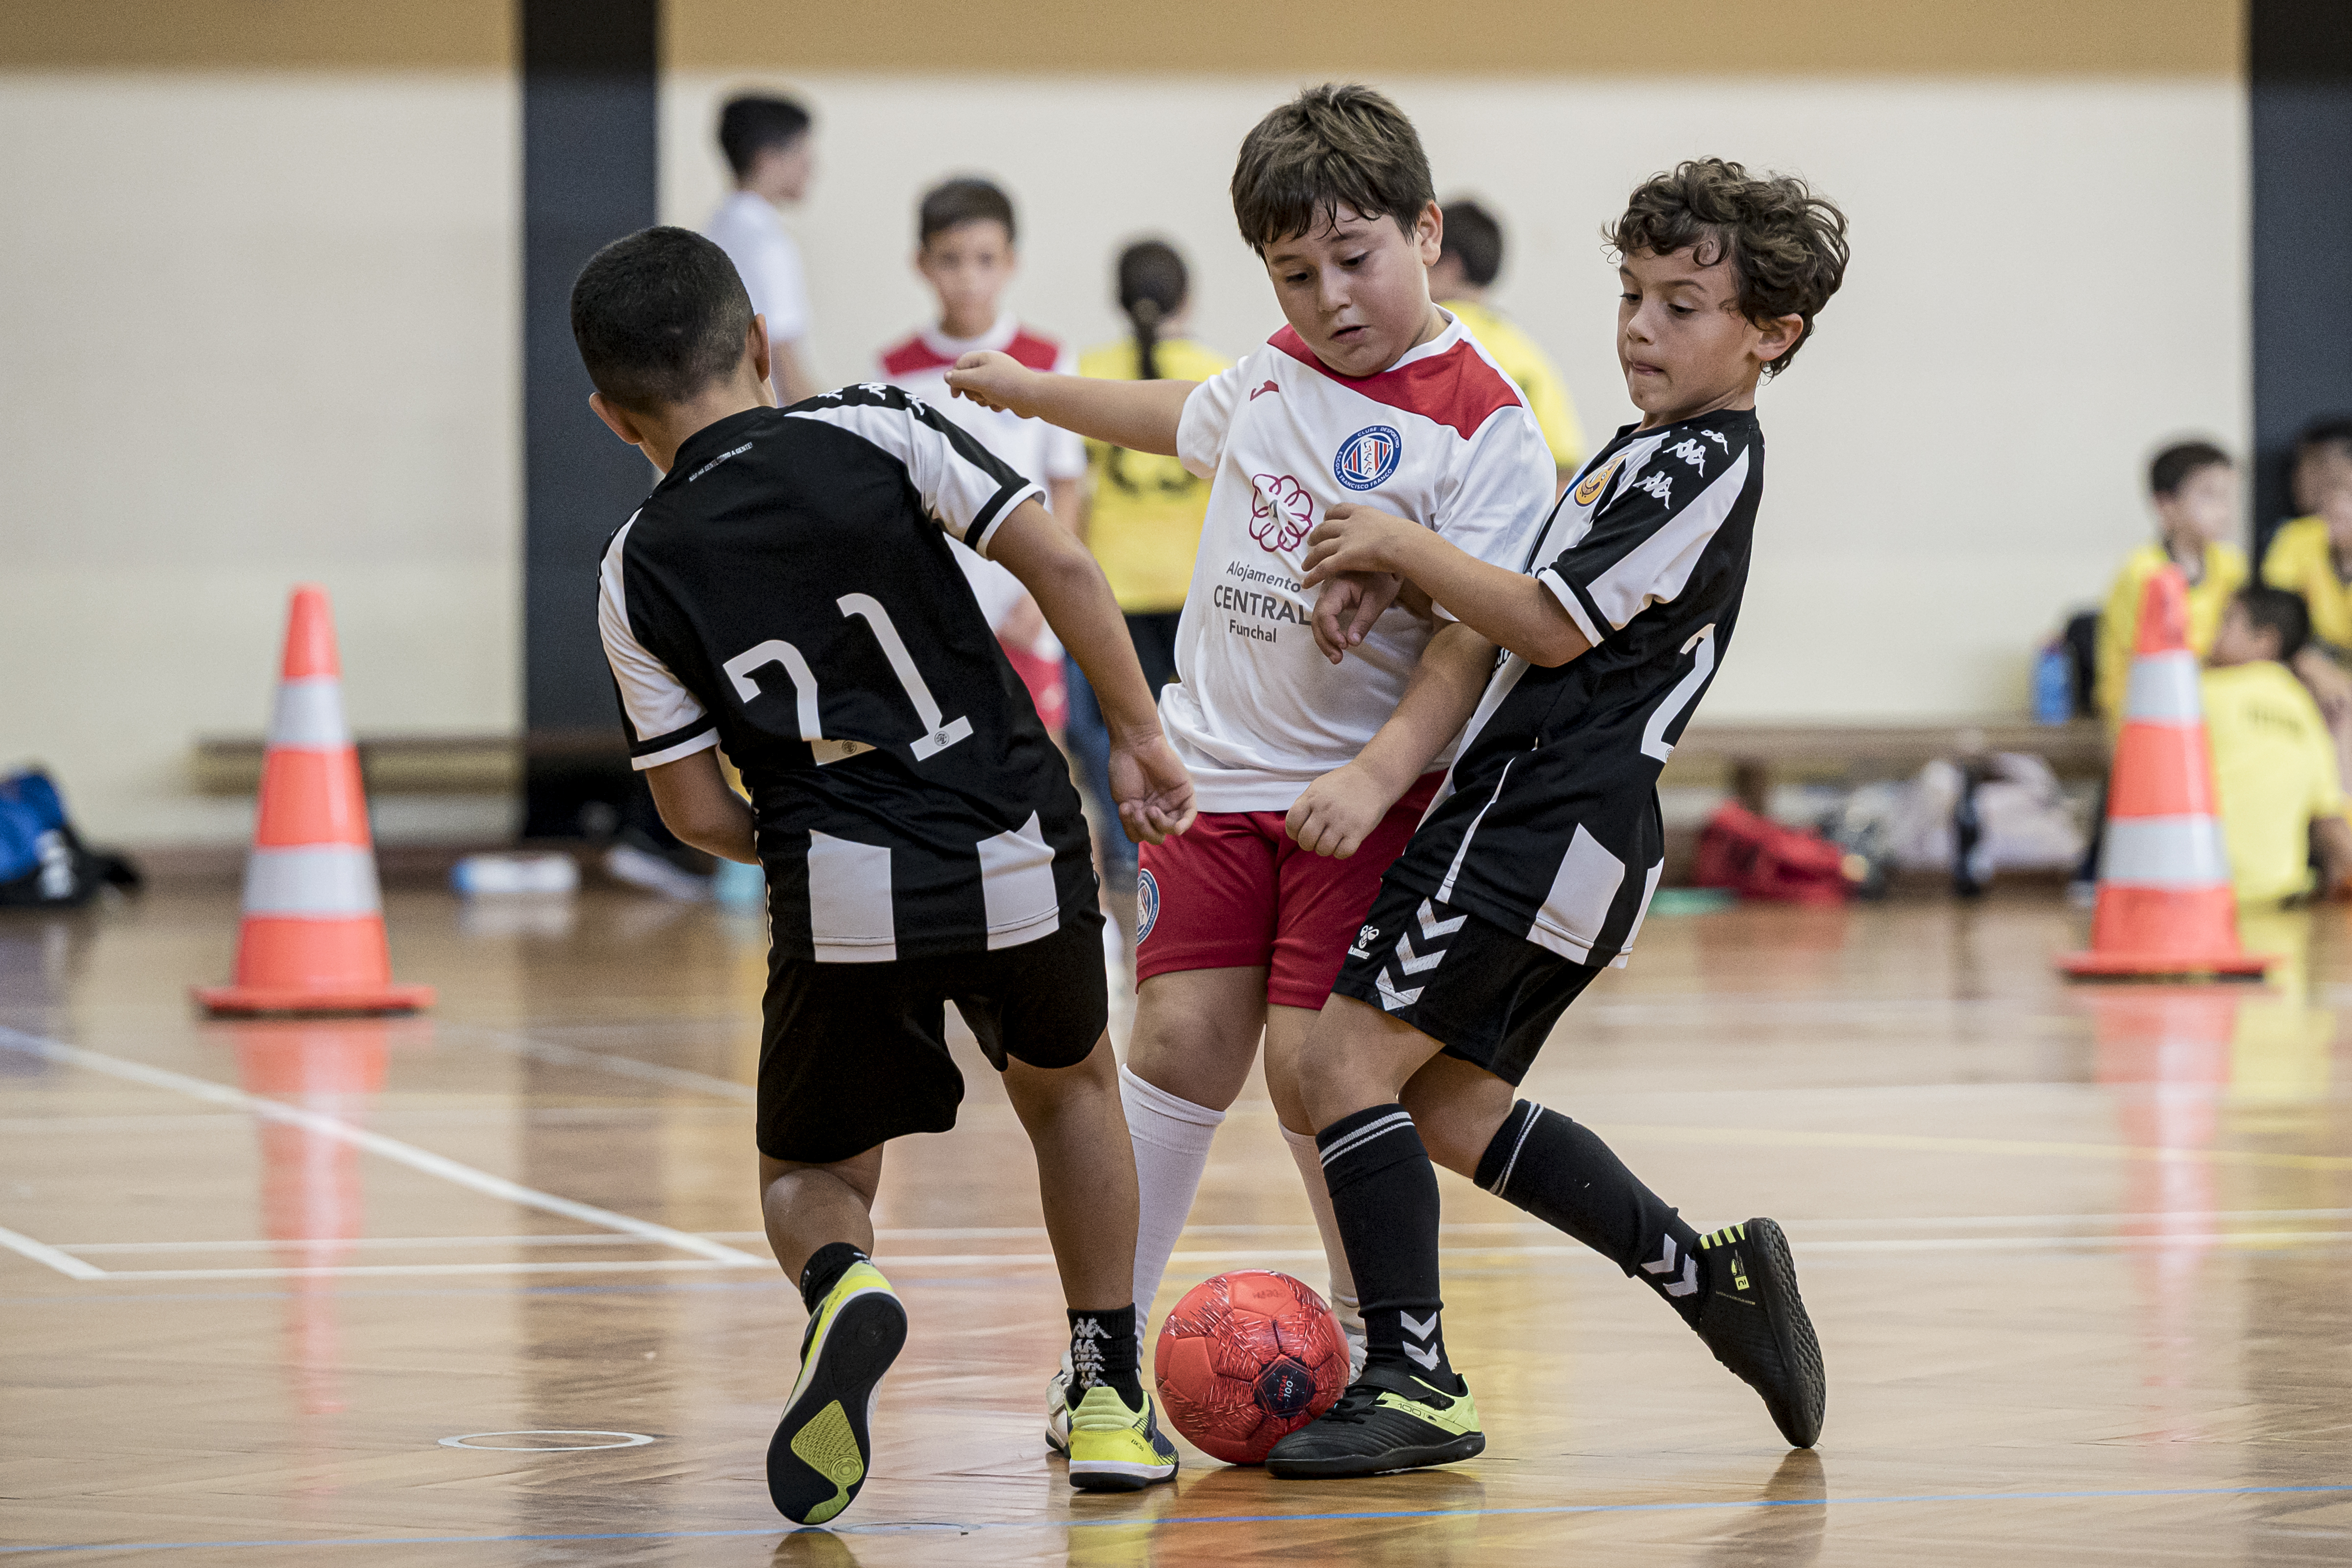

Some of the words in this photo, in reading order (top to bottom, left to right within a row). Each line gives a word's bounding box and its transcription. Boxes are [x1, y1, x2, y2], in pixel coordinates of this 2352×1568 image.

[1358, 427, 1377, 437] CLUBE
[1339, 474, 1369, 489] FRANCISCO
[1370, 468, 1392, 487] FRANCO
[1226, 561, 1301, 593] Alojamento
[1214, 585, 1312, 626] CENTRAL
[1229, 619, 1277, 643] Funchal
[722, 593, 973, 766] 21
[1277, 1375, 1288, 1401] FUTSAL
[1284, 1380, 1293, 1397] 100
[1398, 1403, 1421, 1417] 100
